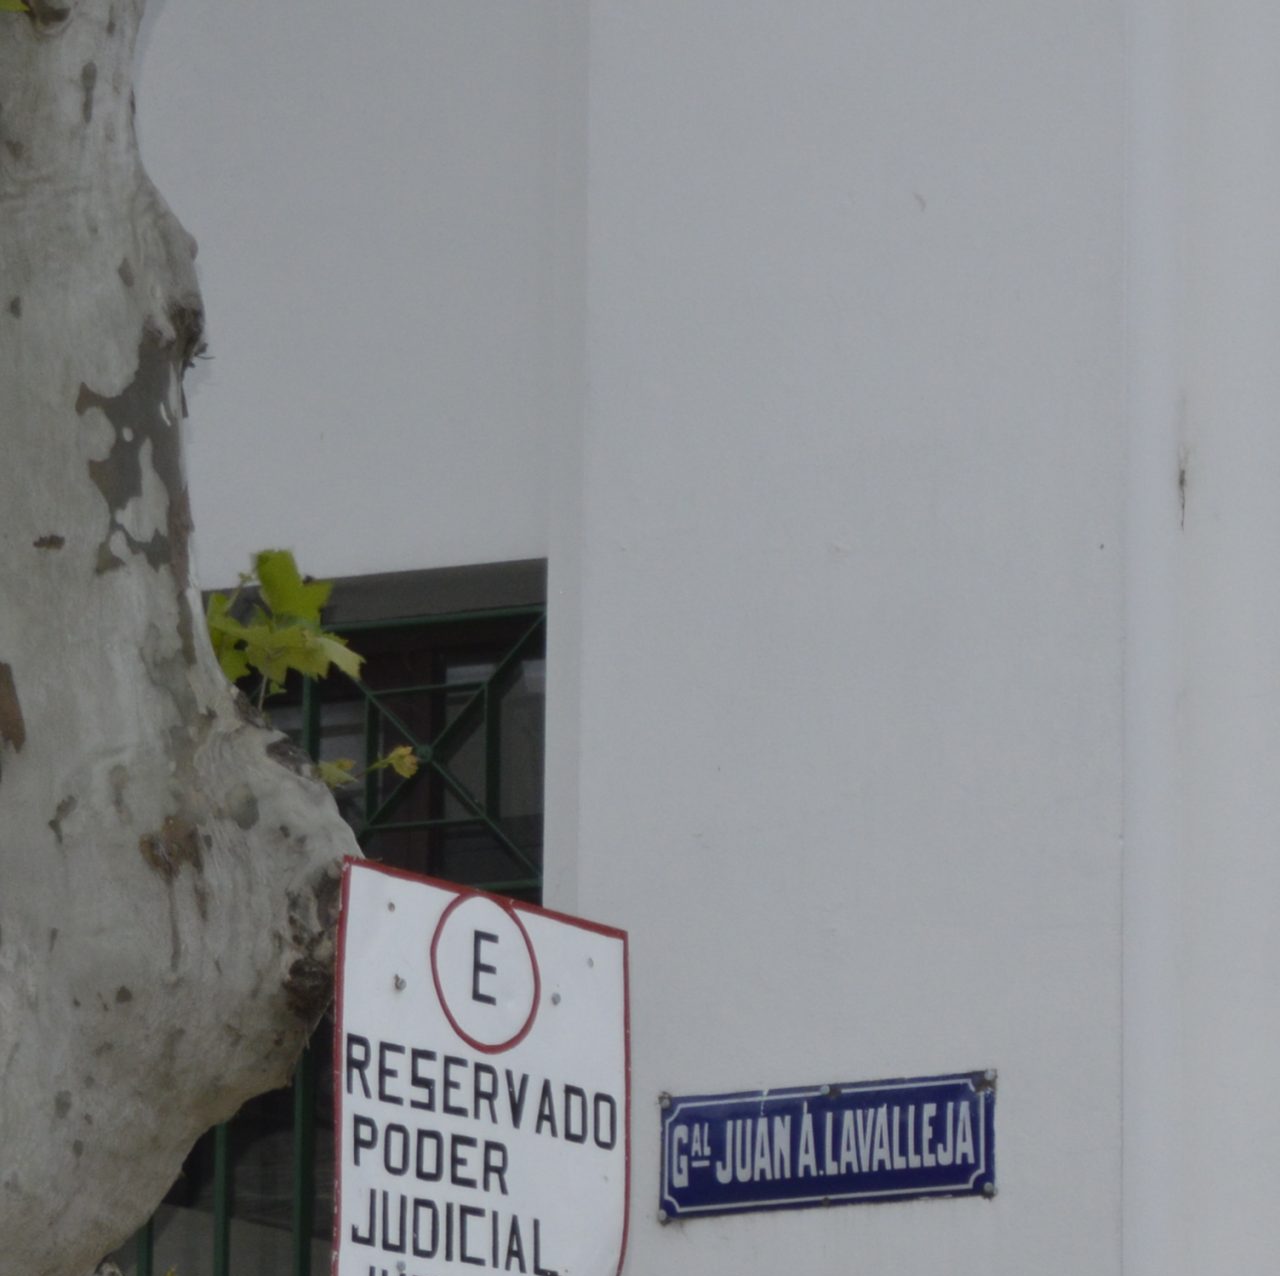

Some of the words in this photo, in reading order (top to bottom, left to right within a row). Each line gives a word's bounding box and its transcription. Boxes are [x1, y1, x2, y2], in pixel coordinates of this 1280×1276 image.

[471, 930, 500, 1005] E
[345, 1033, 618, 1151] RESERVADO
[352, 1114, 509, 1195] PODER
[716, 1115, 792, 1184] JUAN
[826, 1101, 975, 1176] LAVALLEJA
